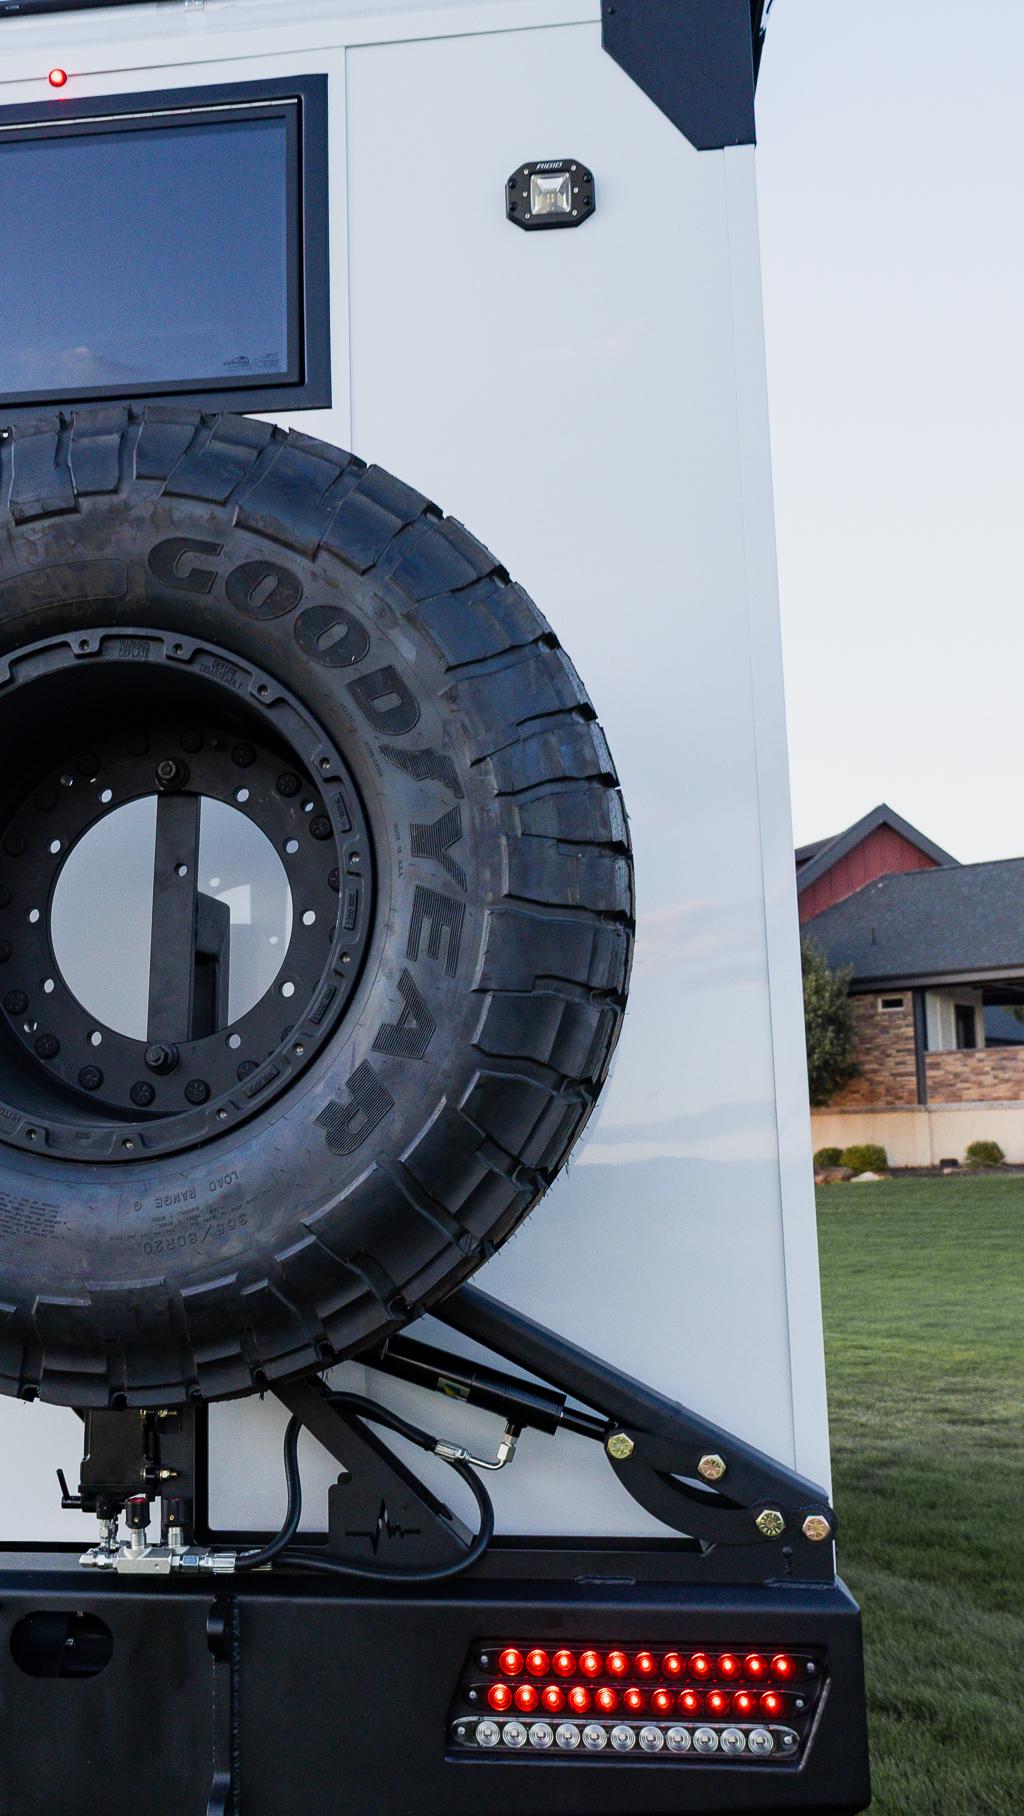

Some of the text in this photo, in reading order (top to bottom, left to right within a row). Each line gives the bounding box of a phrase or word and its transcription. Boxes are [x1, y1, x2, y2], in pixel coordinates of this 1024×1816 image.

[148, 536, 467, 1157] GOODYEAR
[209, 1170, 239, 1192] LOAD
[155, 1187, 197, 1209] RANGE
